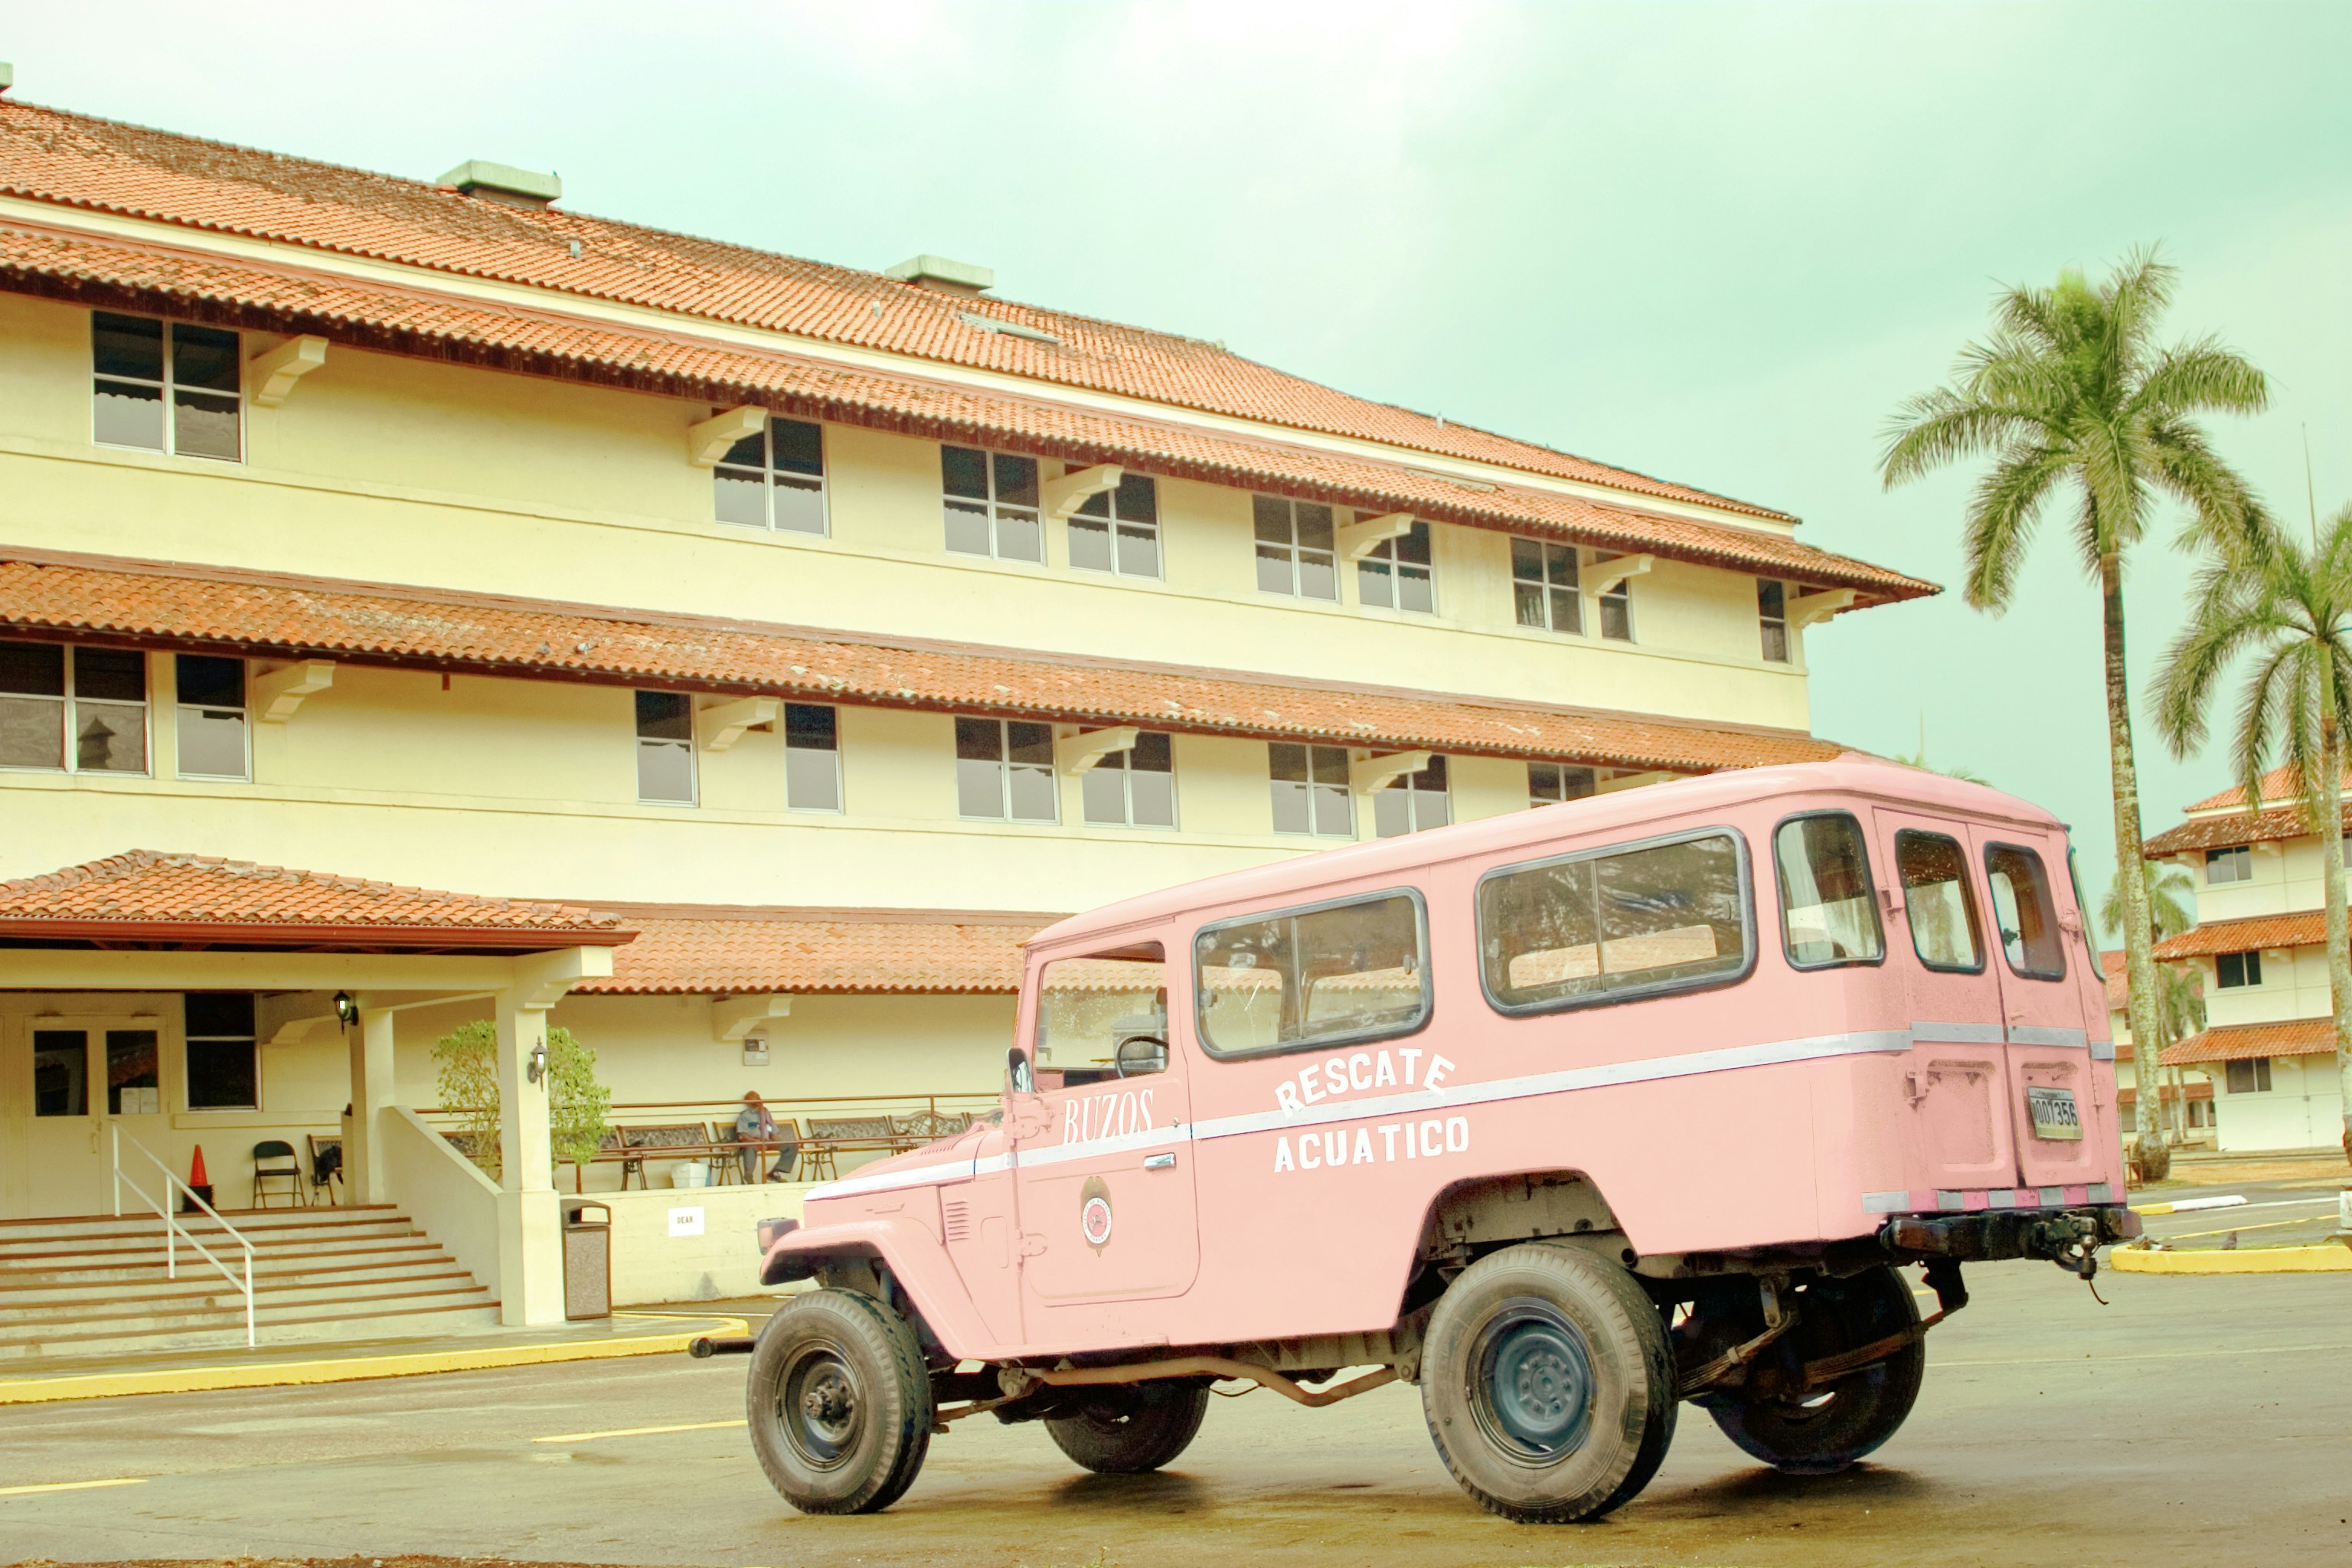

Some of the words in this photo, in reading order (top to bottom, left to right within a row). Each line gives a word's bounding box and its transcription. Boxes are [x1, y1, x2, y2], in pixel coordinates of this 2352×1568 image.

[1275, 1048, 1455, 1119] RESCATE
[1063, 1089, 1154, 1145] BUZOS
[1274, 1116, 1469, 1173] ACUATICO
